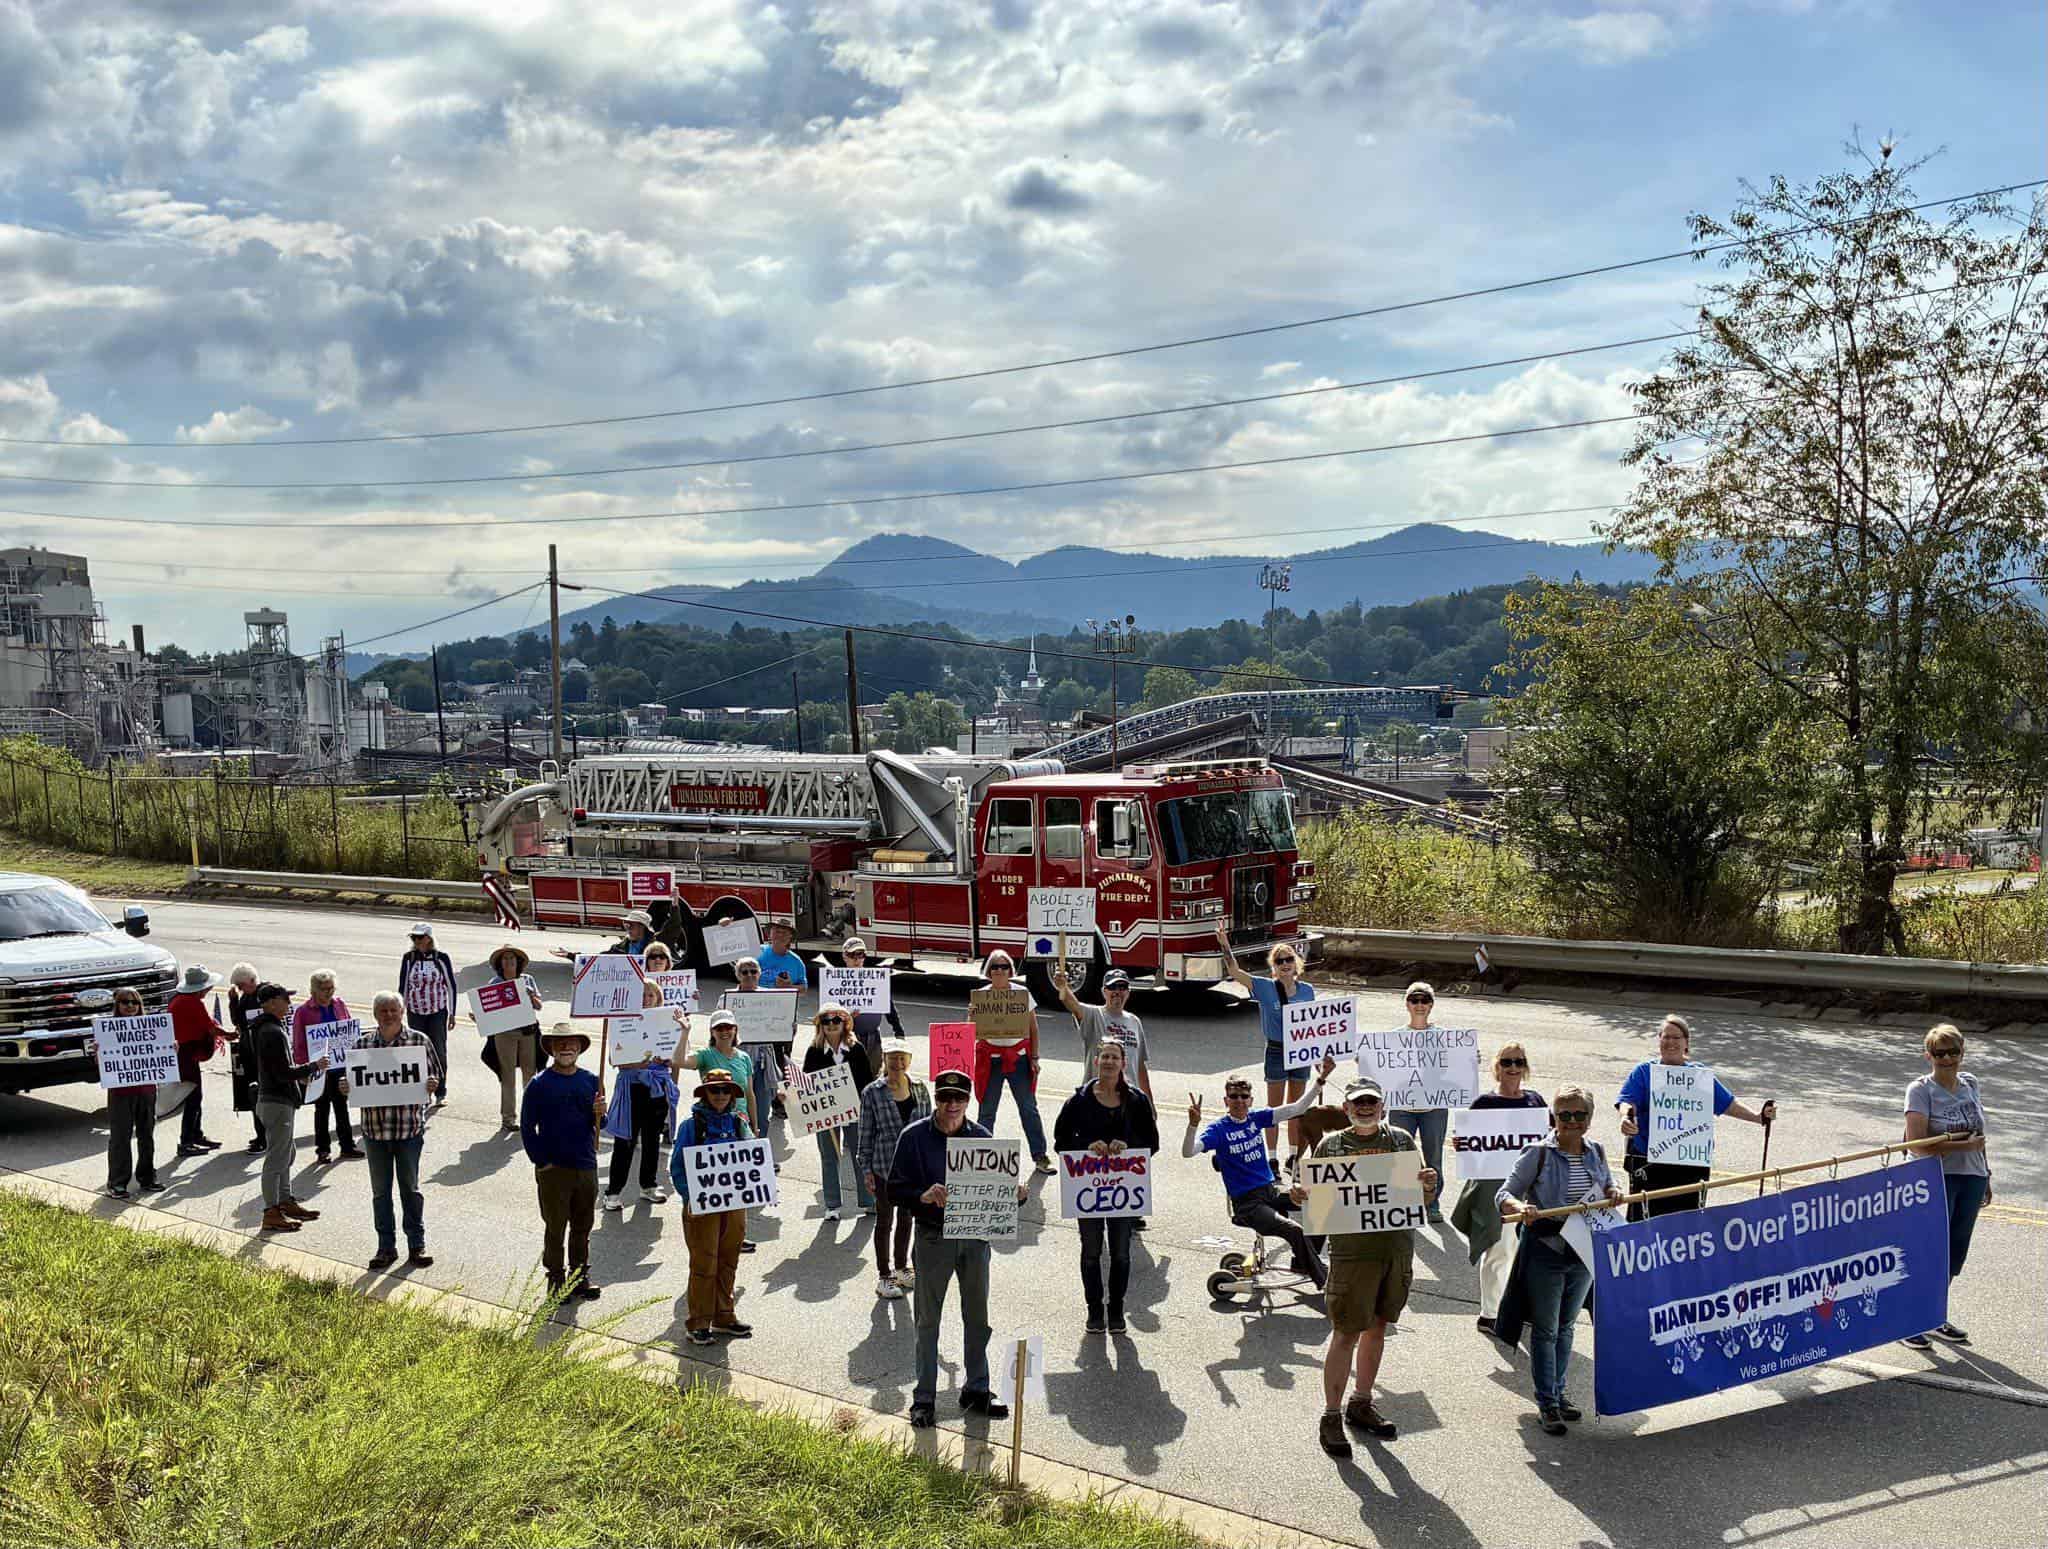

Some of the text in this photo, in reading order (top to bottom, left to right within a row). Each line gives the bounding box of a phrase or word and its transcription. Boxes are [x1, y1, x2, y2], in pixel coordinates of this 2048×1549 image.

[721, 791, 738, 805] FIRE
[991, 874, 1024, 884] LADDER
[1099, 872, 1152, 892] JUNALUSKA
[1000, 886, 1016, 896] 18
[1100, 892, 1152, 903] FIRE DEPT.
[1030, 894, 1095, 909] ABOLISH
[1070, 938, 1088, 947] NO
[32, 962, 91, 973] SUPER
[826, 969, 855, 980] PUBLIC
[828, 987, 876, 996] CORPORATE
[1290, 1001, 1352, 1023] LIVING
[101, 1016, 168, 1032] FAIR LIVING
[1290, 1020, 1347, 1042] WAGES
[115, 1029, 157, 1042] WAGES
[1358, 1029, 1476, 1050] ALL WORKERS
[122, 1043, 154, 1056] OVER
[1288, 1041, 1353, 1064] FOR ALL
[104, 1055, 177, 1073] BILLIONAIRE
[1377, 1050, 1448, 1069] DESERVE
[118, 1068, 166, 1083] PROFITS
[1408, 1069, 1423, 1087] A
[1666, 1070, 1695, 1091] help
[797, 1076, 848, 1099] PLANET
[1424, 1089, 1471, 1105] WAGE
[801, 1095, 837, 1115] OVER
[1652, 1091, 1704, 1112] Workers
[1657, 1113, 1684, 1130] not
[1649, 1123, 1710, 1159] Billionaires
[696, 1144, 765, 1170] Living
[947, 1148, 1020, 1177] UNIONS
[697, 1169, 761, 1190] wage
[1307, 1162, 1358, 1184] TAX
[696, 1184, 771, 1211] for all
[946, 1184, 1017, 1198] BETTER PAY
[1076, 1185, 1144, 1213] CEOS
[1338, 1184, 1388, 1206] THE
[945, 1200, 981, 1211] BETTER
[944, 1213, 1014, 1224] BETTER FOR
[1361, 1205, 1425, 1230] RICH
[1607, 1178, 1930, 1277] Workers Over Billionaires
[1654, 1295, 1730, 1334] HANDS
[1788, 1251, 1897, 1298] HAYWOOD
[1740, 1346, 1827, 1379] We are Indivisible
